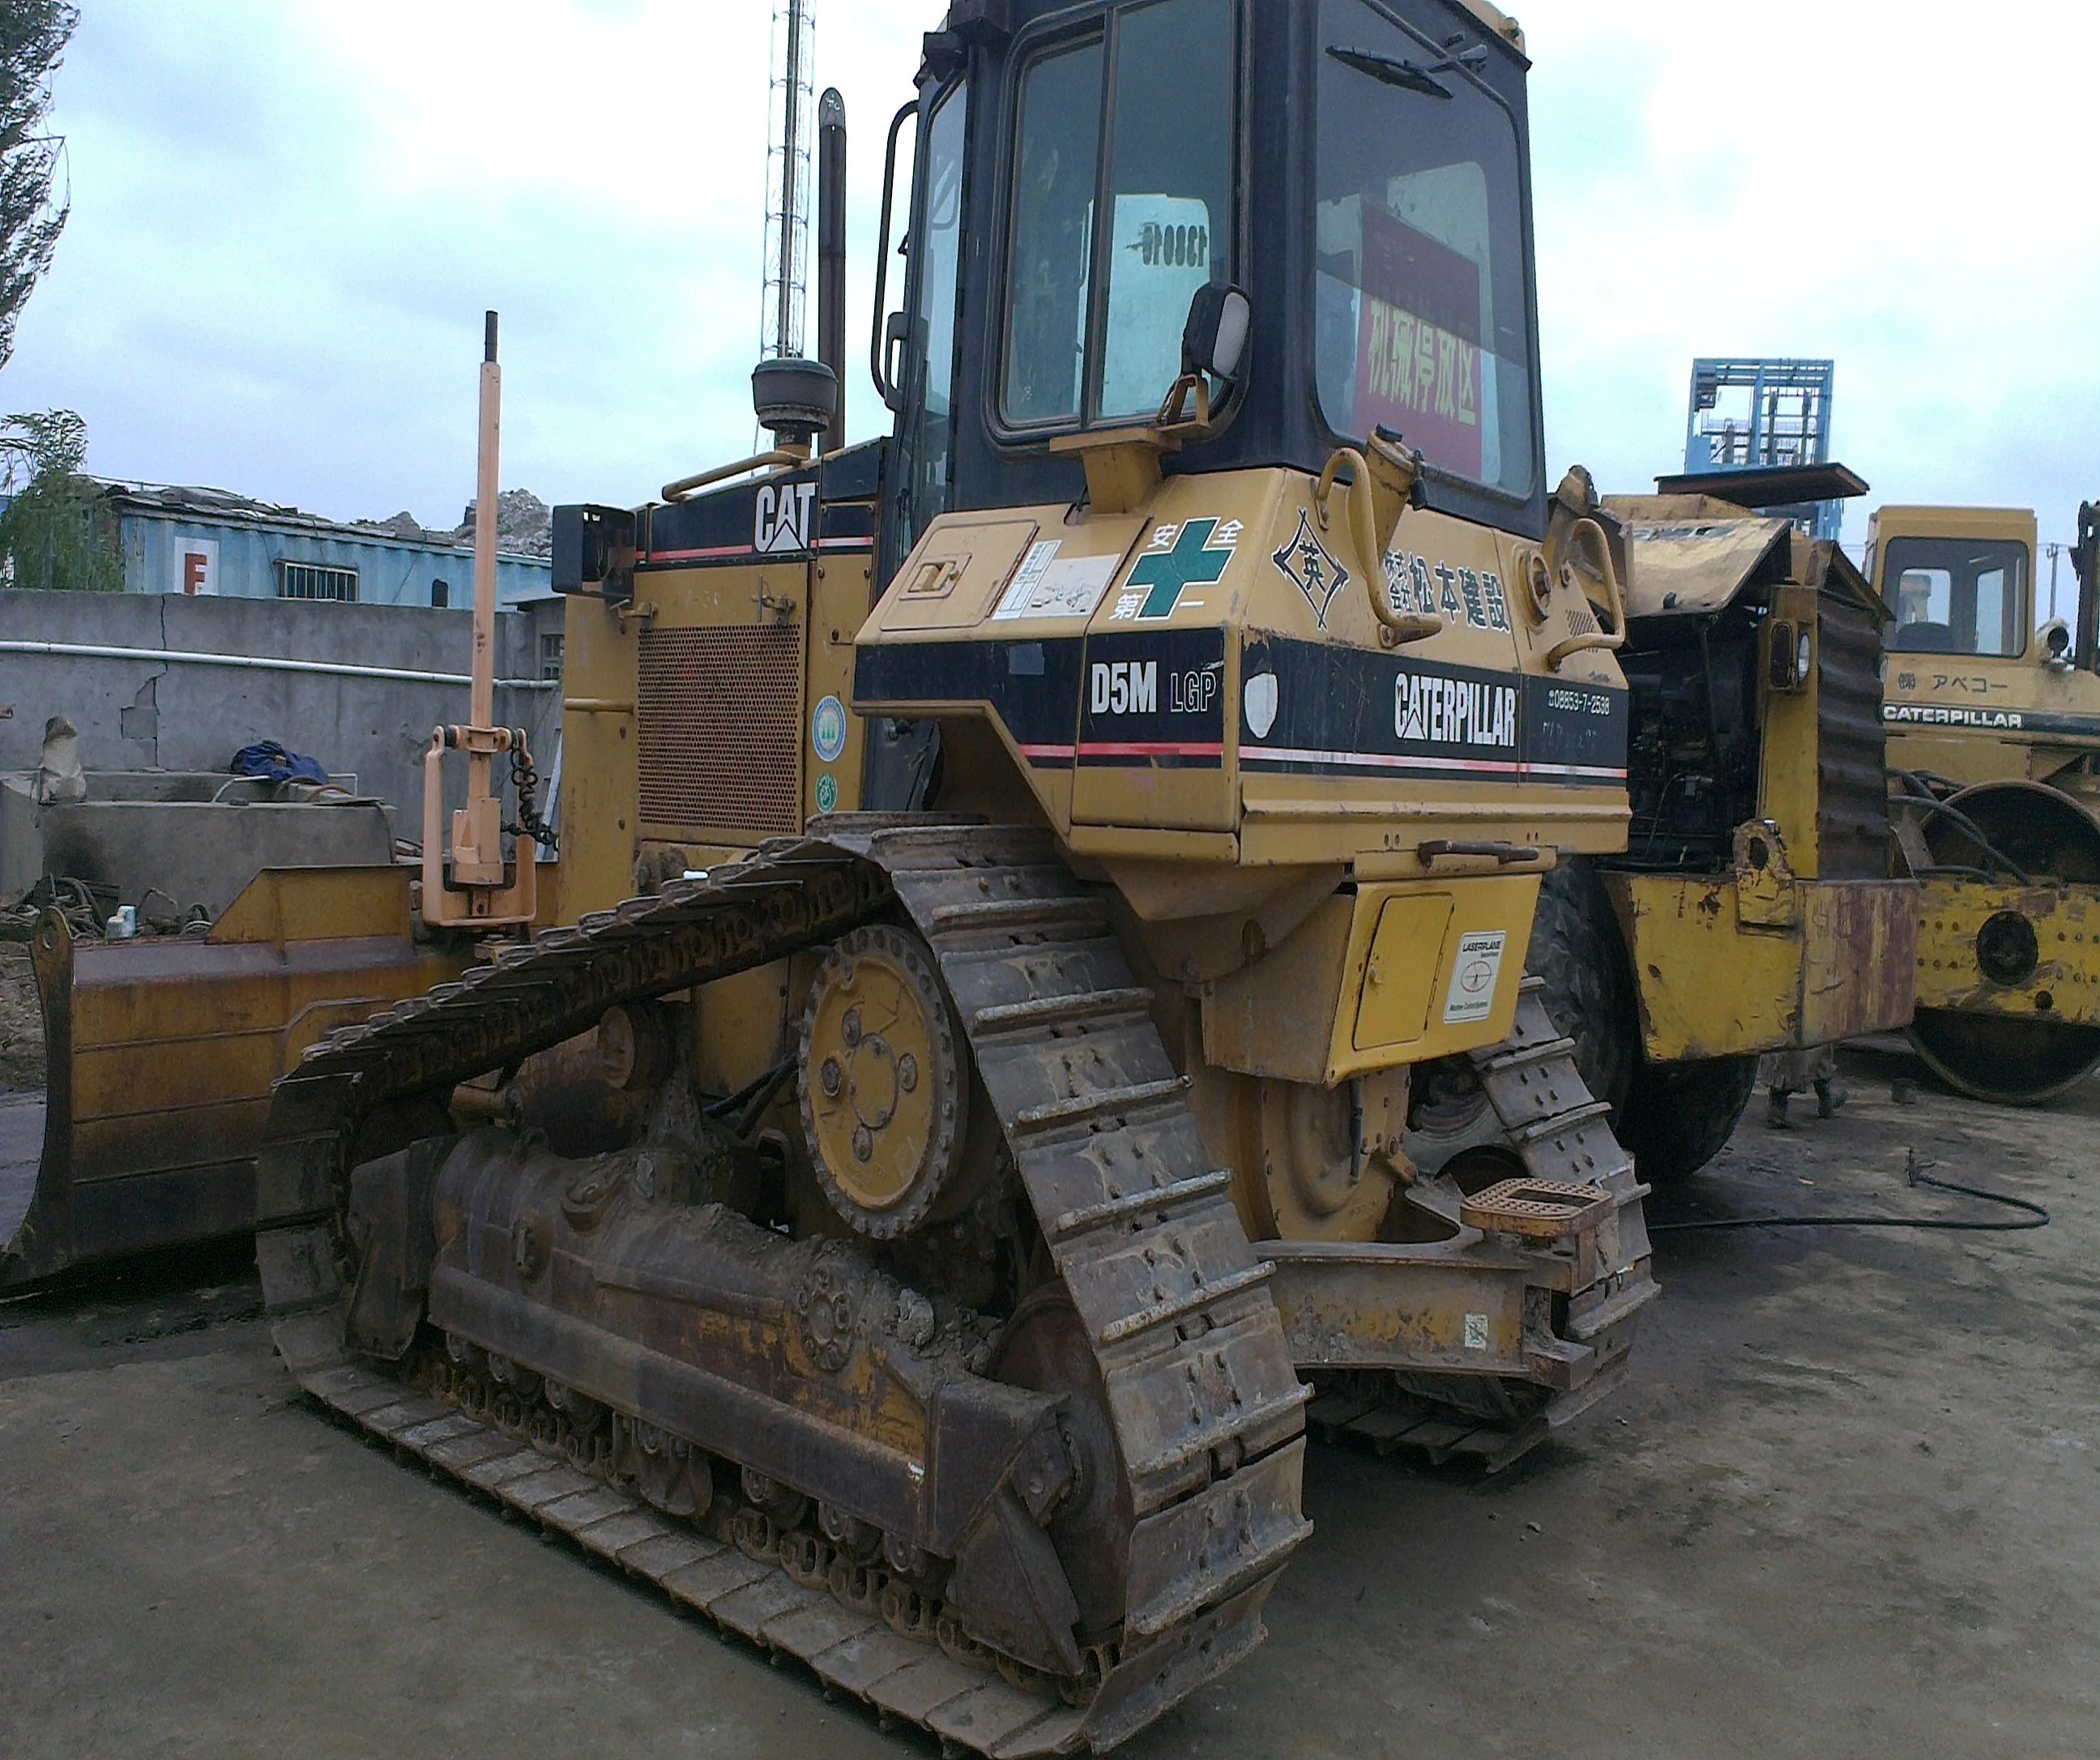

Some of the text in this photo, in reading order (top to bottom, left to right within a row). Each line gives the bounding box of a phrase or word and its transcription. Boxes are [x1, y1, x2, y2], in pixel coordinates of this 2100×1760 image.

[755, 483, 816, 553] CAT
[184, 553, 207, 595] F
[1298, 539, 1329, 594] 英
[1091, 661, 1216, 714] D5M LGP
[1394, 673, 1515, 747] CATERPILLAR
[1884, 706, 2022, 728] CATERPILLAR
